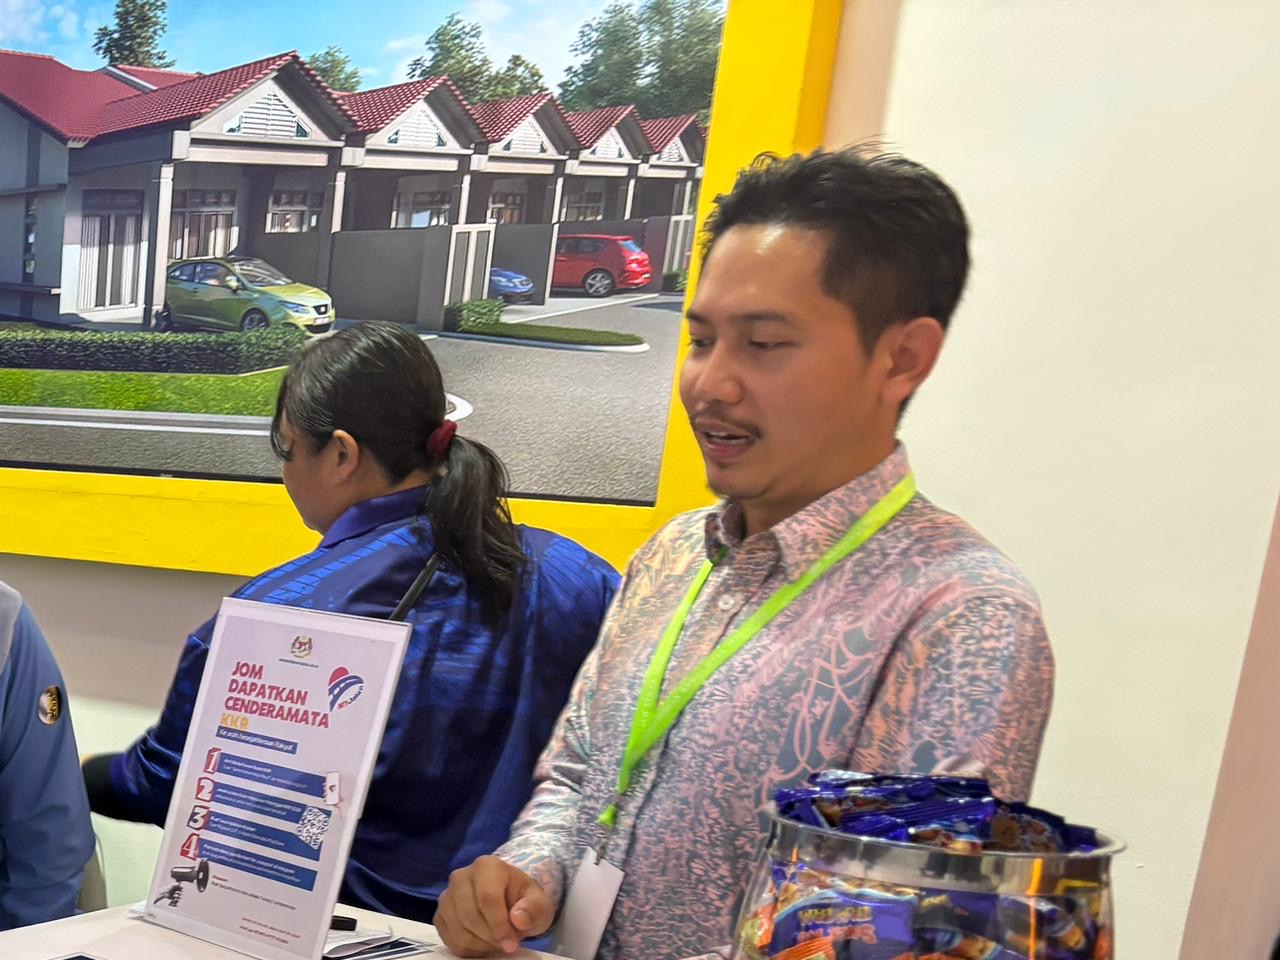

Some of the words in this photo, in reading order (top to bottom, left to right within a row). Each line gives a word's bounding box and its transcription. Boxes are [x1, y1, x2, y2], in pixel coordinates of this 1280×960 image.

[232, 661, 264, 680] JOM
[228, 678, 309, 706] DAPATKAN
[224, 696, 330, 729] CENDERAMATA
[204, 747, 221, 774] 1
[195, 777, 216, 802] 2
[187, 805, 210, 830] 3
[181, 833, 200, 861] 4
